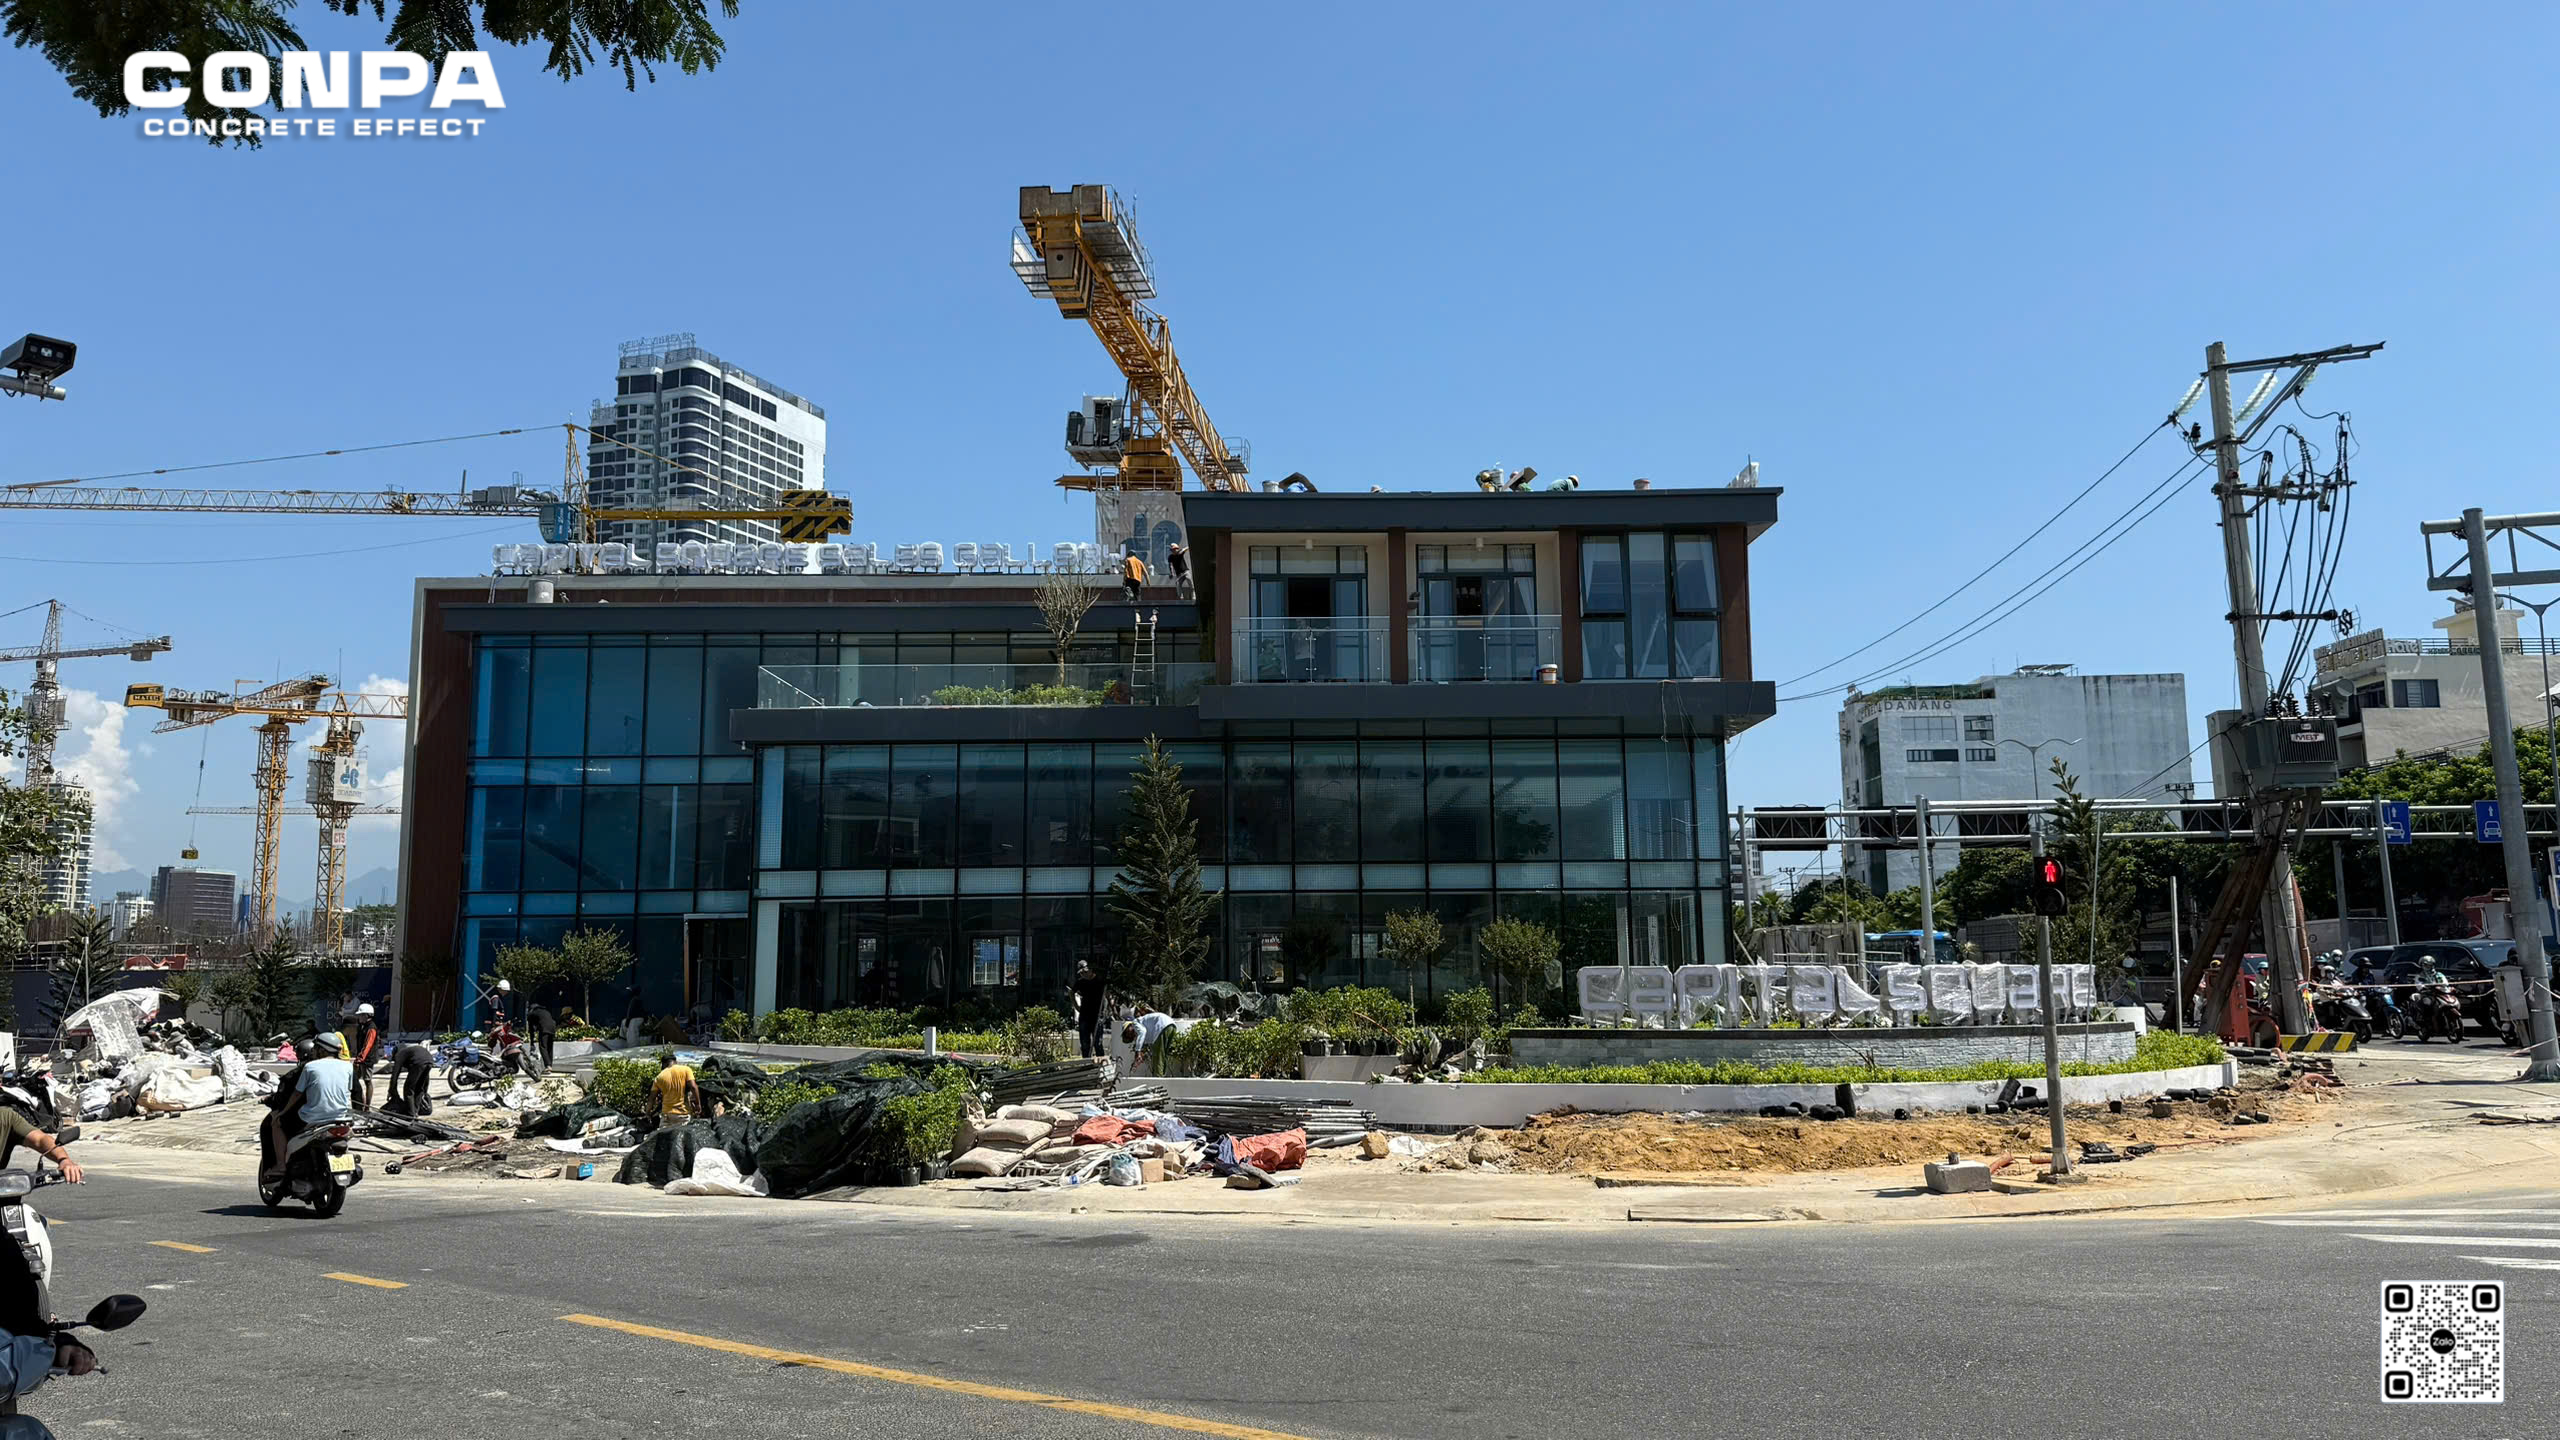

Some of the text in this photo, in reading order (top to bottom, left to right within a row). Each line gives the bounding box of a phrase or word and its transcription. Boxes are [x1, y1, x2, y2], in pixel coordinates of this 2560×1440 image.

[816, 542, 943, 567] SALES
[953, 542, 1127, 568] GALLERY
[1884, 700, 1952, 710] DANANG
[1577, 965, 1879, 1014] CAPITAL
